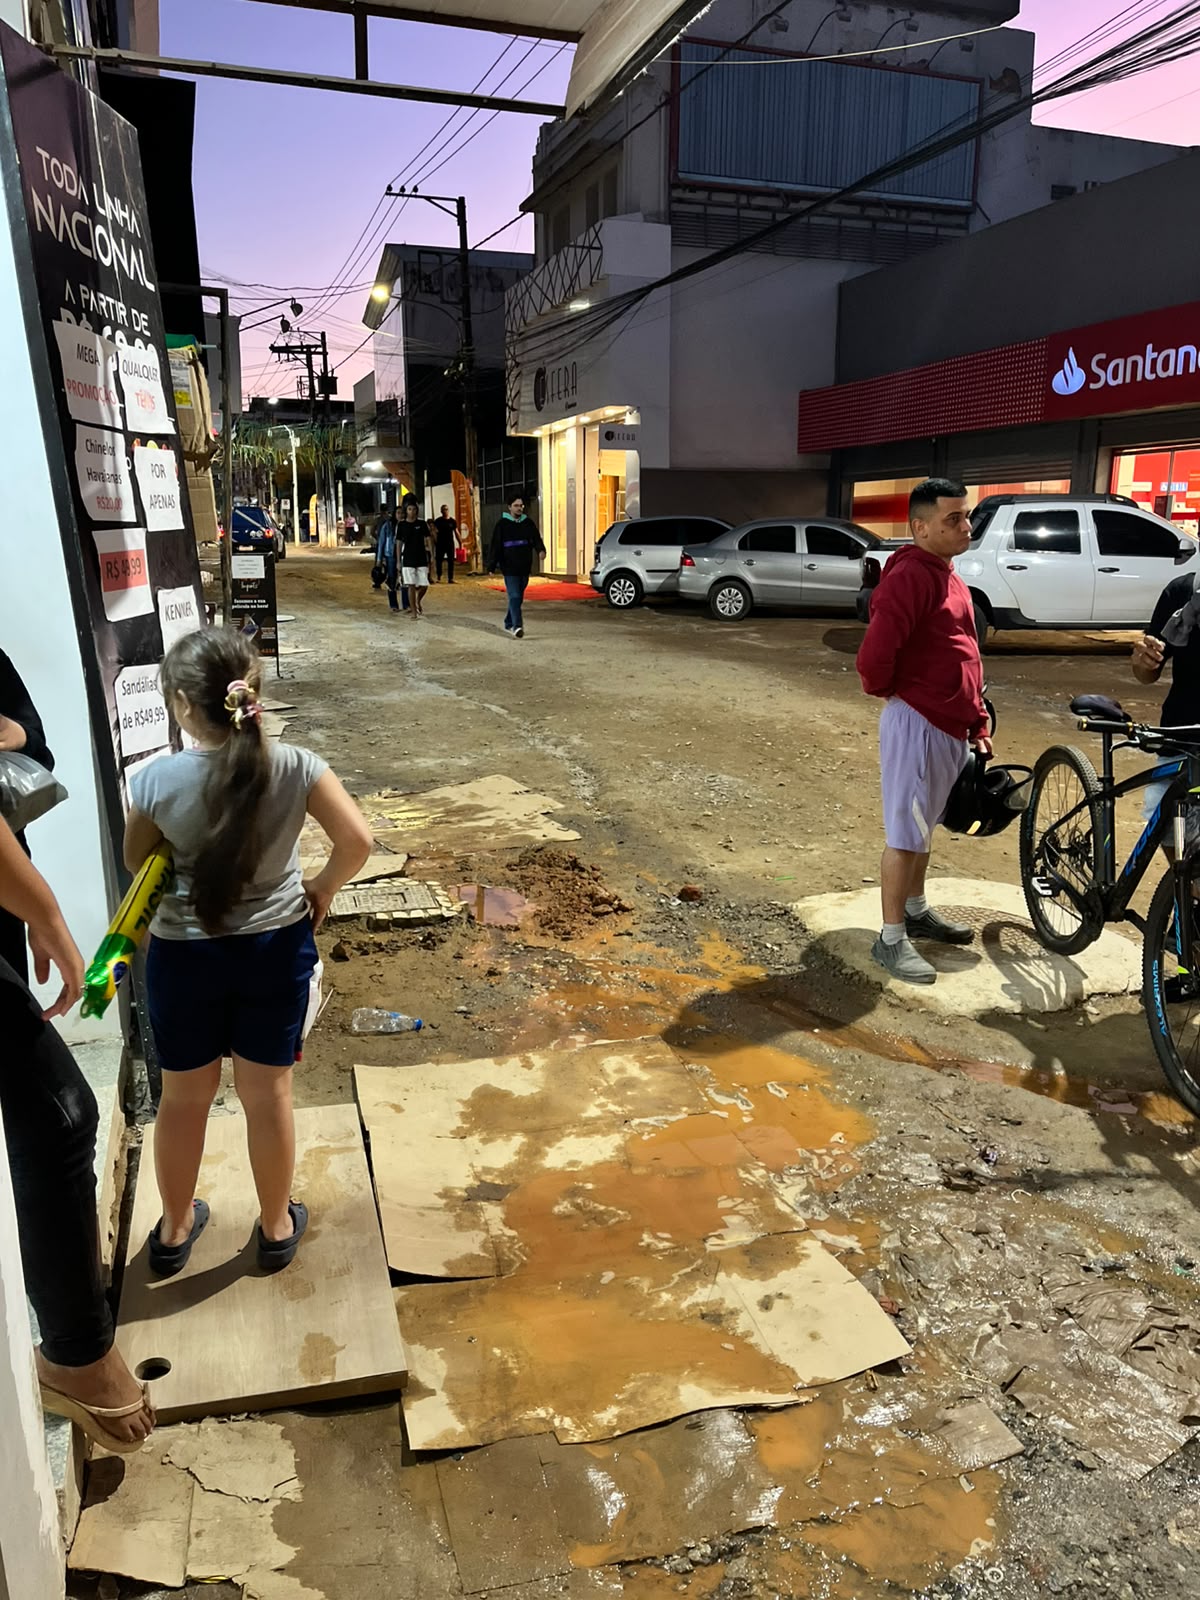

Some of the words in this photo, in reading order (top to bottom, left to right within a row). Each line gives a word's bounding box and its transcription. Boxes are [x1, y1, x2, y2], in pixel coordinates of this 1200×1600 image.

[36, 146, 89, 205] TODA
[93, 182, 141, 238] LINHA
[31, 186, 155, 292] NACIONAL
[65, 280, 76, 304] A
[79, 284, 128, 327] PARTIR
[131, 308, 151, 337] DE
[77, 343, 100, 367] MEGA
[1089, 343, 1200, 389] Santan
[66, 379, 117, 406] PROMOÇÃO
[85, 438, 116, 457] Chinelos
[86, 467, 122, 485] Havaianas
[150, 463, 167, 479] POR
[149, 494, 176, 509] APENAS
[105, 561, 120, 581] R$
[164, 601, 194, 622] KENNER
[121, 676, 158, 696] Sandálias
[122, 712, 133, 730] de
[134, 706, 166, 728] R$49,99
